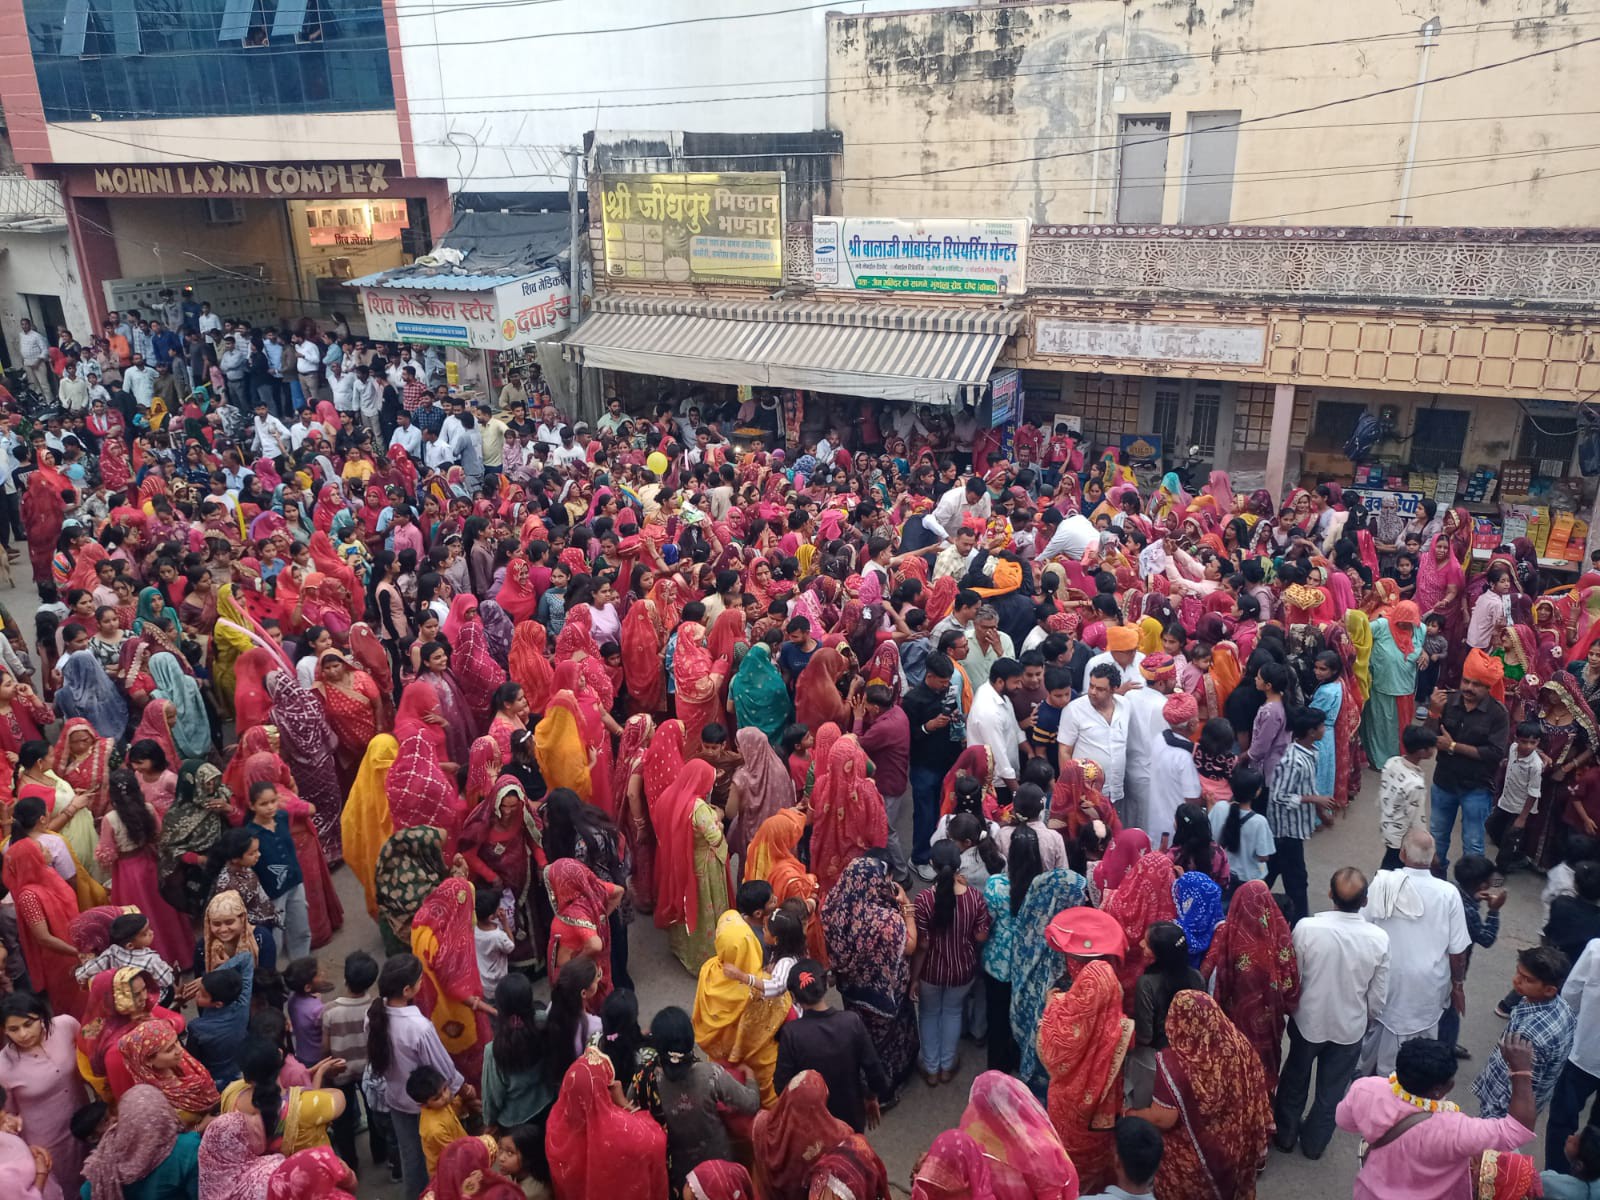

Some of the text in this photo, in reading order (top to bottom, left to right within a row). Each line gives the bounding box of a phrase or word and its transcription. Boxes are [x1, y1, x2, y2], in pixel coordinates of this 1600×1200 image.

[95, 163, 389, 194] MOHINI LAXMI COMPLEX
[606, 182, 632, 220] श्री
[718, 215, 776, 235] भण्डार
[849, 234, 861, 257] श्री
[863, 235, 900, 258] बालाजी
[902, 234, 942, 261] मोबाईल
[366, 291, 395, 315] शिव
[458, 298, 496, 321] स्टोर
